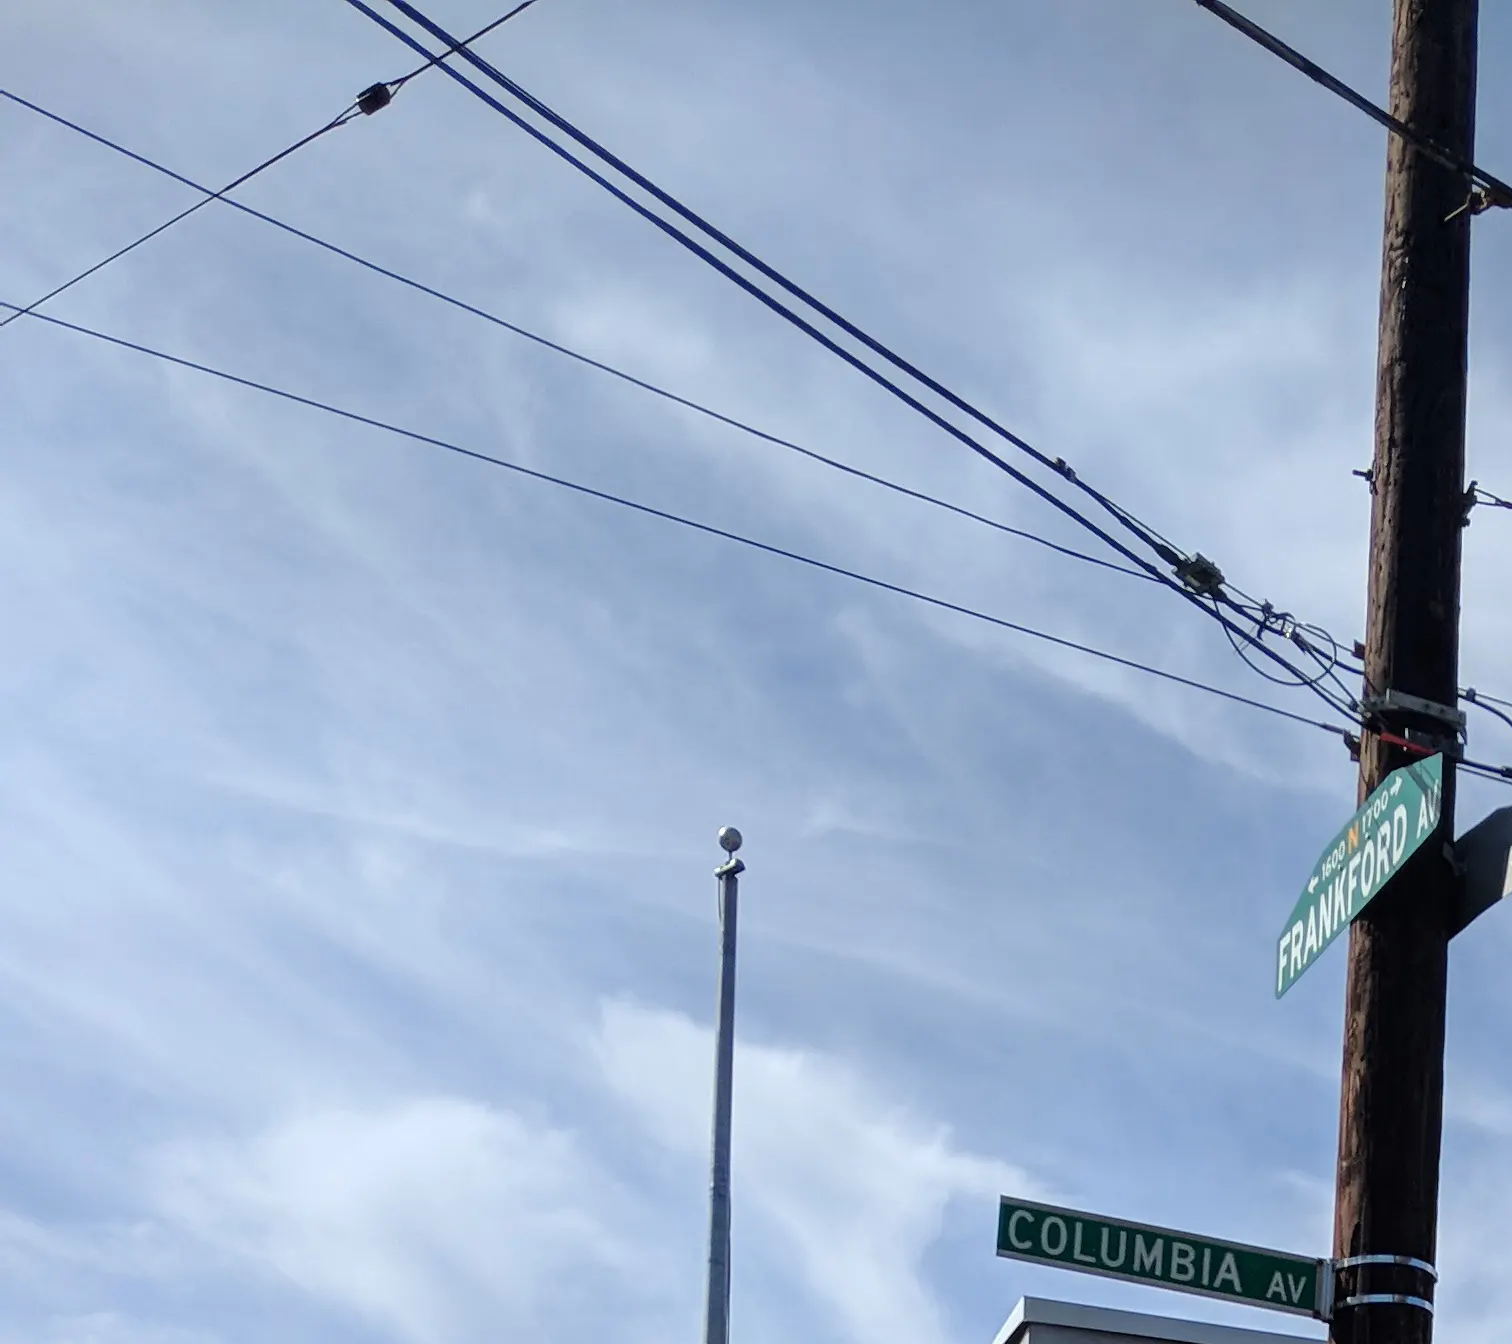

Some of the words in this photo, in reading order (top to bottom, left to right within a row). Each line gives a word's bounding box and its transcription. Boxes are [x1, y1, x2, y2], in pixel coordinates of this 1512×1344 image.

[1320, 840, 1346, 882] 1600
[1347, 822, 1360, 854] N
[1362, 790, 1389, 836] 1700
[1277, 803, 1408, 992] FRANKFORD
[1007, 1209, 1243, 1294] COLUMBIA
[1266, 1270, 1308, 1305] AV
